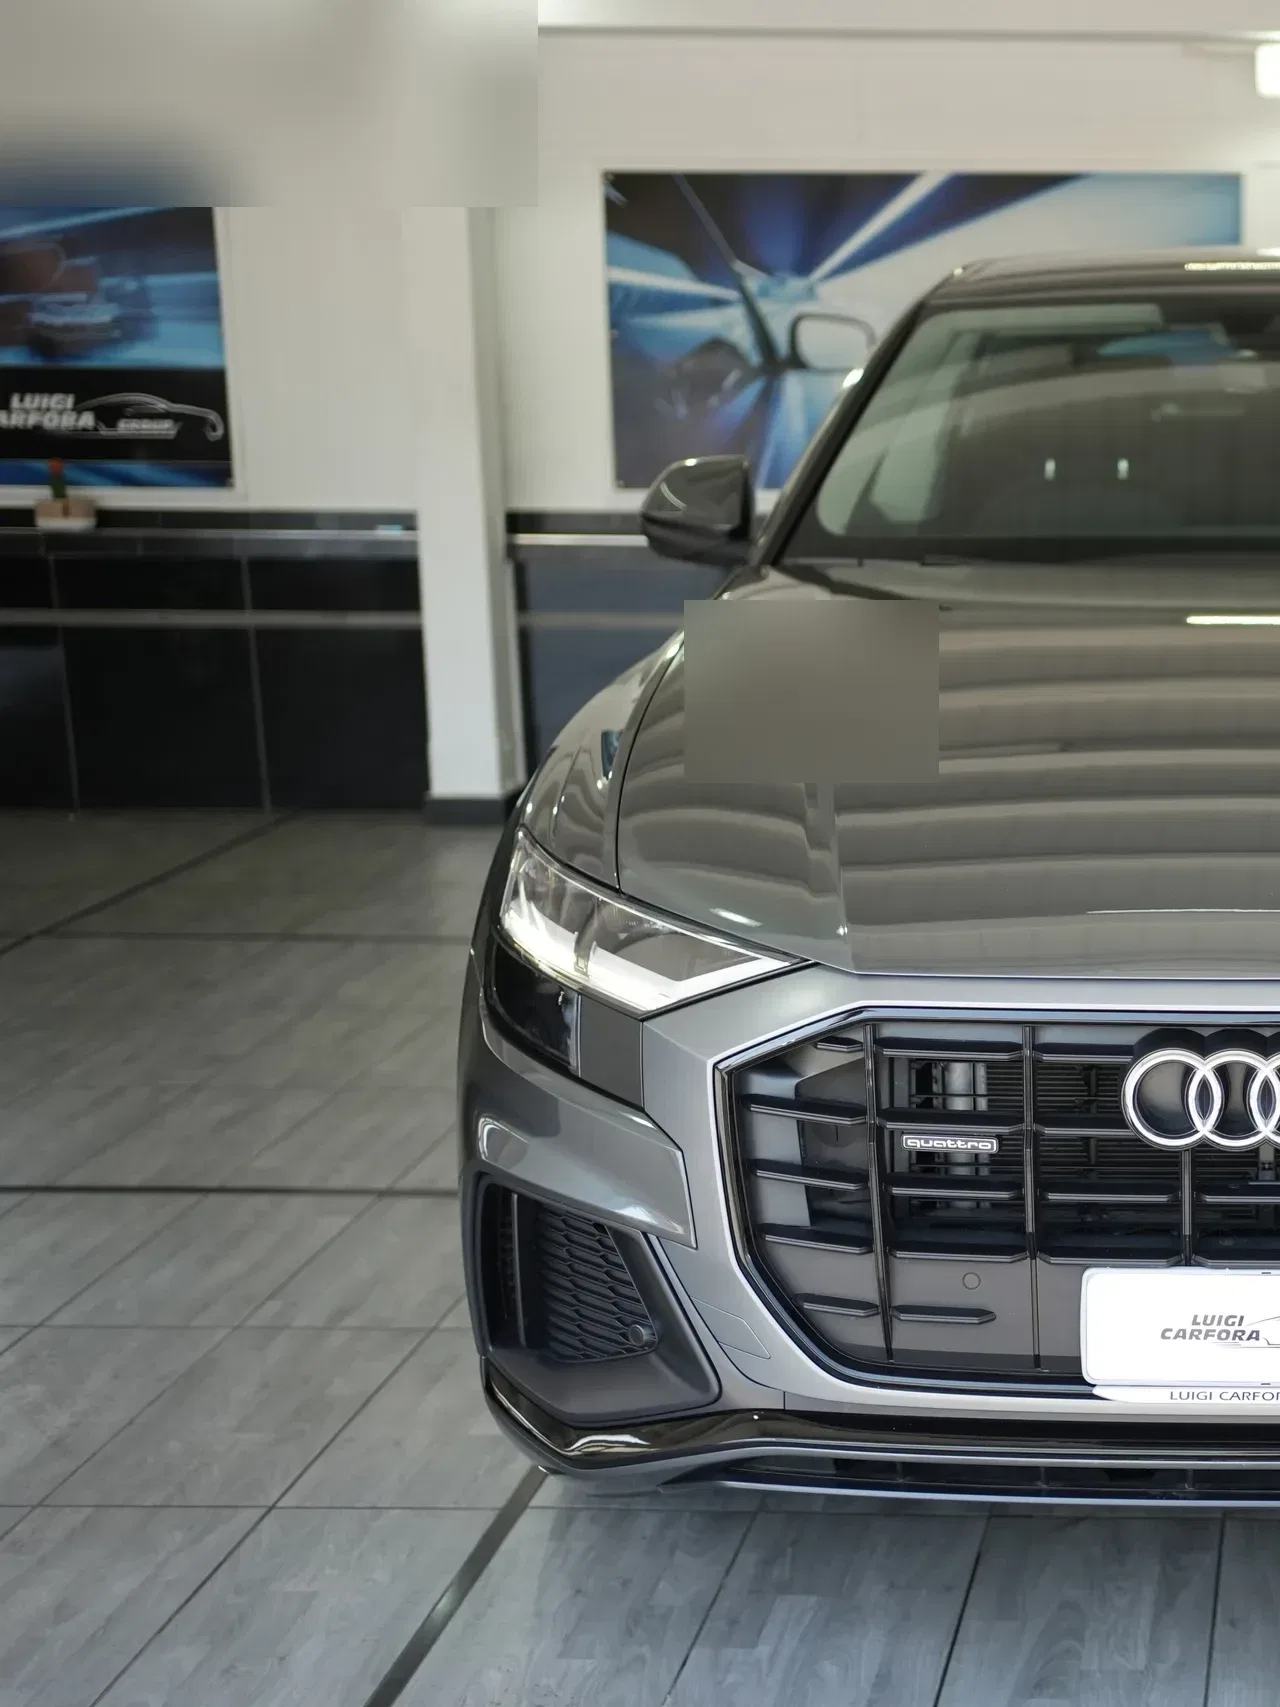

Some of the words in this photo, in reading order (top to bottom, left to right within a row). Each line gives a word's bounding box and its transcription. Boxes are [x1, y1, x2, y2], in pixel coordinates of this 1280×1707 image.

[10, 392, 75, 410] LUIGI
[906, 1138, 992, 1150] quattro
[1191, 1314, 1245, 1327] LUIGI
[1160, 1328, 1260, 1342] CARFORA
[1170, 1391, 1213, 1401] LUIGI
